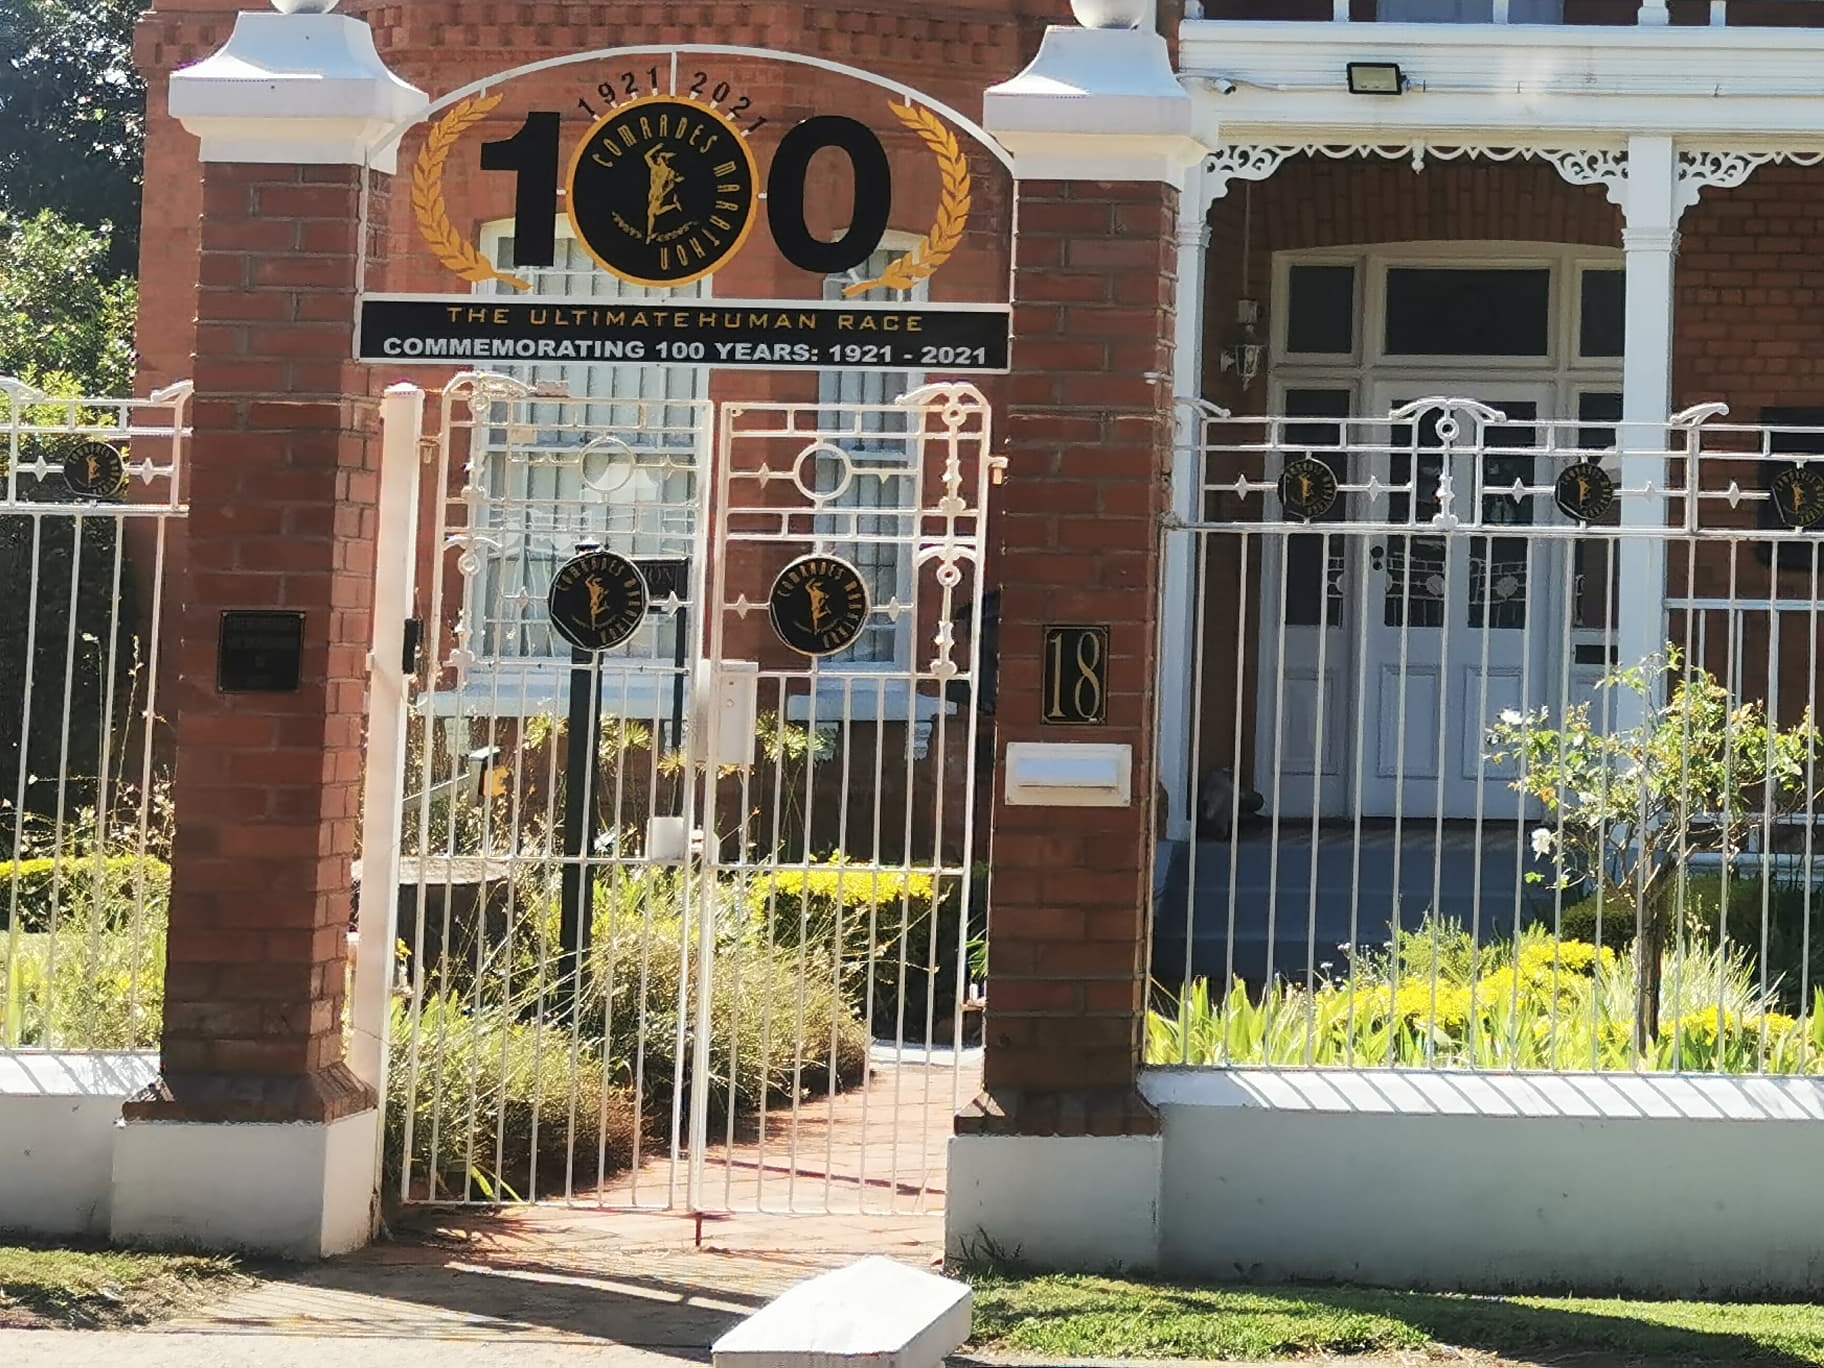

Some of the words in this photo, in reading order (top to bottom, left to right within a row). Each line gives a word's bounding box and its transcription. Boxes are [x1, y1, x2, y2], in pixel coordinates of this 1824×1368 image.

[577, 66, 661, 119] 1921
[690, 70, 769, 133] 2021
[592, 113, 720, 169] COMRADES
[659, 160, 741, 271] MARATHON
[383, 338, 646, 360] COMMEMORATING
[654, 341, 706, 361] 100
[715, 341, 819, 363] YEARS:
[828, 343, 892, 364] 1921
[920, 345, 988, 366] 2021
[447, 307, 510, 324] THE
[530, 308, 689, 329] ULTIMATE
[698, 311, 818, 331] HUMAN
[838, 314, 924, 332] RACE
[1048, 630, 1101, 719] 18
